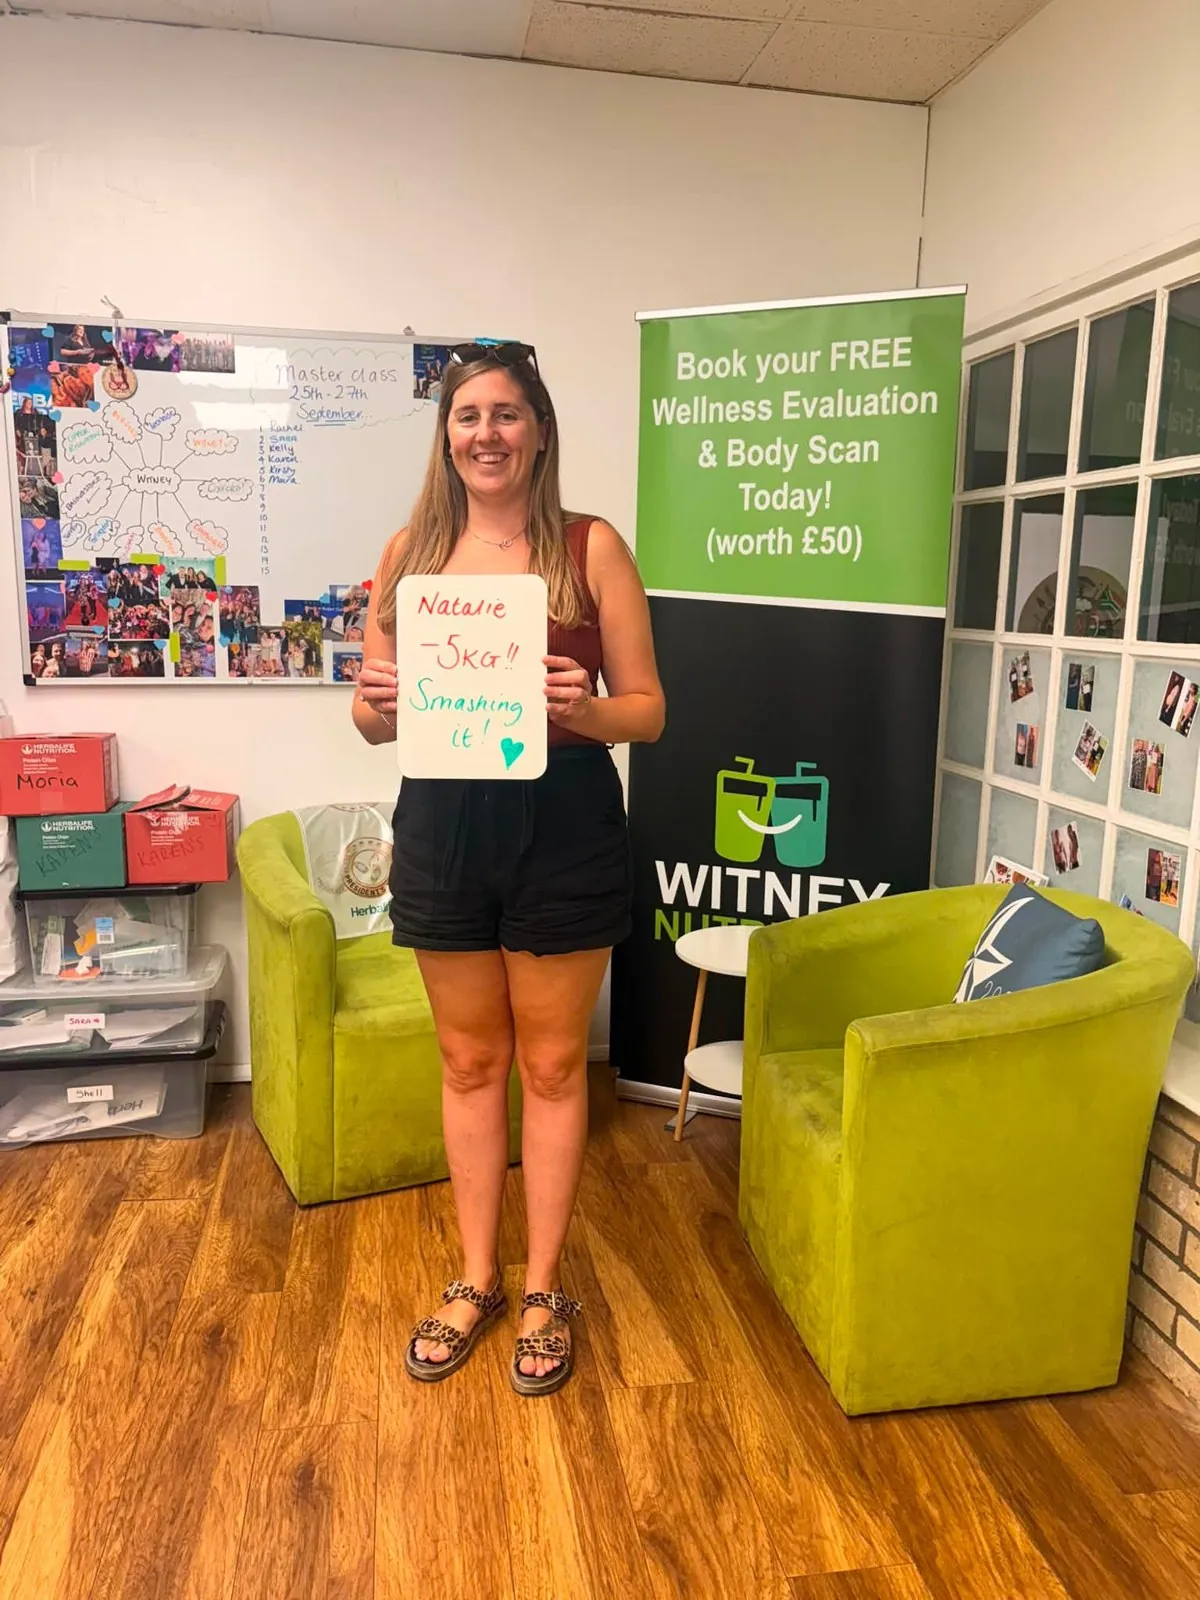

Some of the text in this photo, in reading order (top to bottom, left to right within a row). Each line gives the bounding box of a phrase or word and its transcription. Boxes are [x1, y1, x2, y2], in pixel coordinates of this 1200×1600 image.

[676, 336, 913, 383] Book your FREE
[276, 364, 398, 385] Master class
[289, 385, 323, 401] 25th
[334, 384, 368, 400] 27th
[652, 385, 939, 426] Wellness Evaluation
[269, 444, 295, 456] Kelly
[698, 434, 879, 472] & Body Scan
[738, 481, 831, 517] Today!
[261, 545, 269, 553] 13
[706, 525, 863, 562] (worth £50)
[261, 556, 269, 565] 14
[261, 567, 270, 576] 15
[417, 591, 508, 619] Natalie
[409, 677, 523, 727] Smashing
[16, 772, 78, 790] Moria
[76, 1088, 103, 1099] Shell
